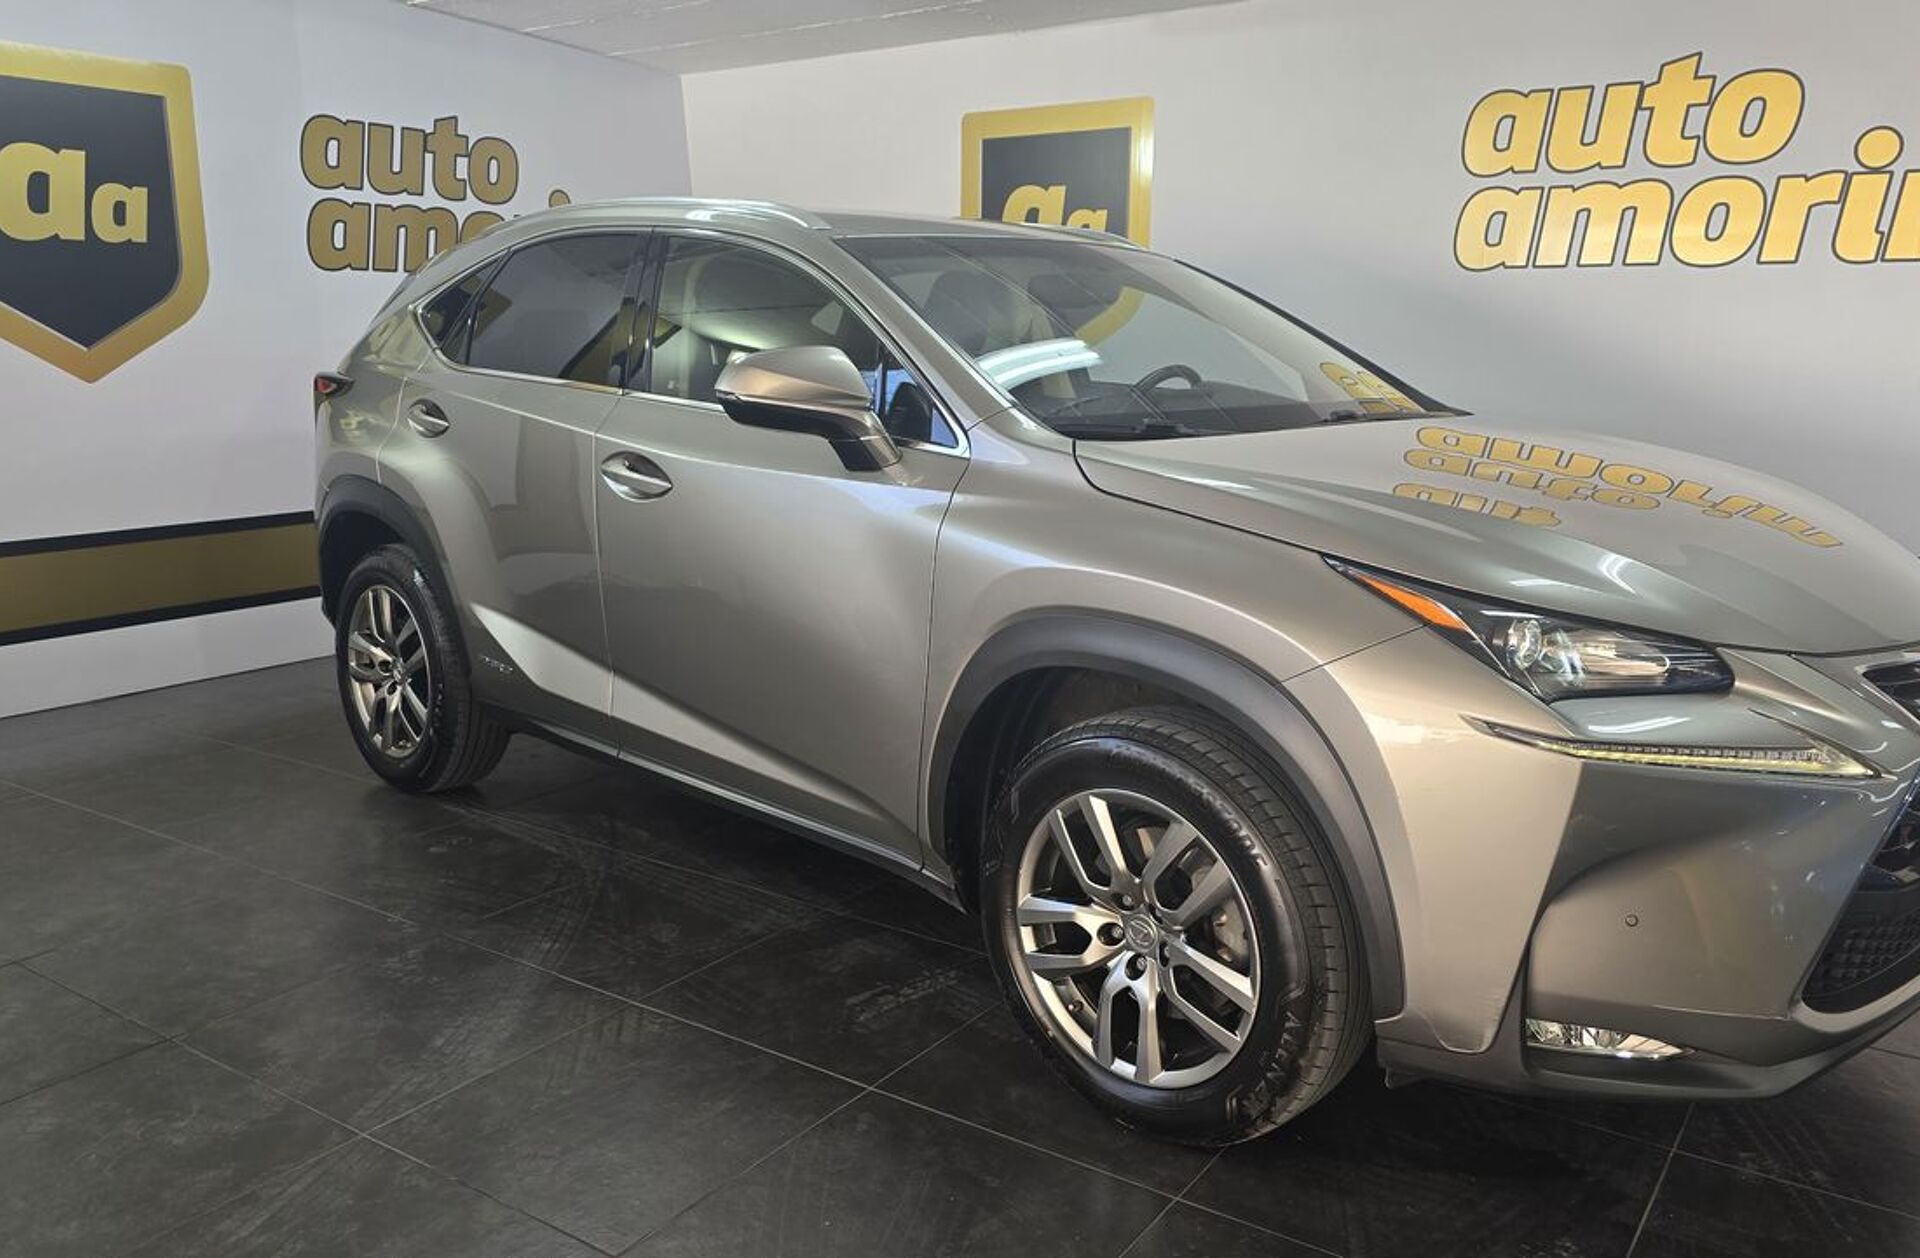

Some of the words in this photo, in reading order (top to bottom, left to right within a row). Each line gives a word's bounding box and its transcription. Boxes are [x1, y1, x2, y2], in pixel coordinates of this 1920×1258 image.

[301, 114, 518, 205] auto
[1461, 52, 1805, 177] auto
[1454, 125, 1920, 270] amori
